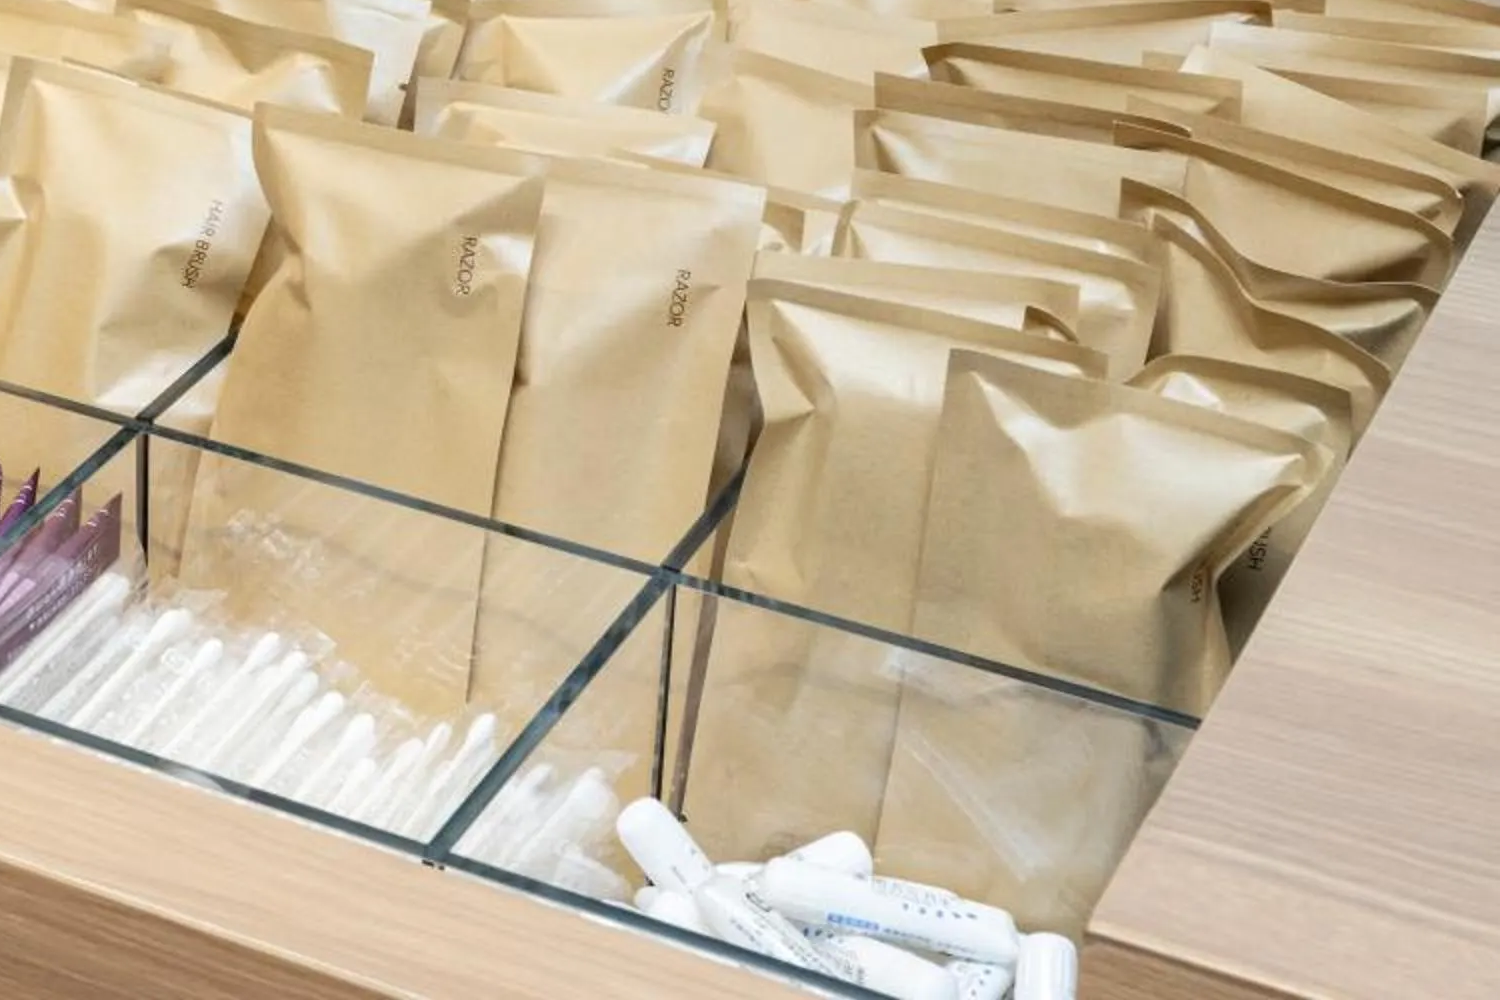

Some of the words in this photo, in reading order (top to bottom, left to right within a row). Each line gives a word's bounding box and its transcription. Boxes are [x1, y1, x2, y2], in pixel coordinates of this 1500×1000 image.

[658, 67, 676, 113] RAZO
[200, 199, 223, 237] HAIR
[180, 239, 211, 289] BRUSH
[455, 236, 478, 297] RAZOR
[666, 268, 692, 328] RAZOR
